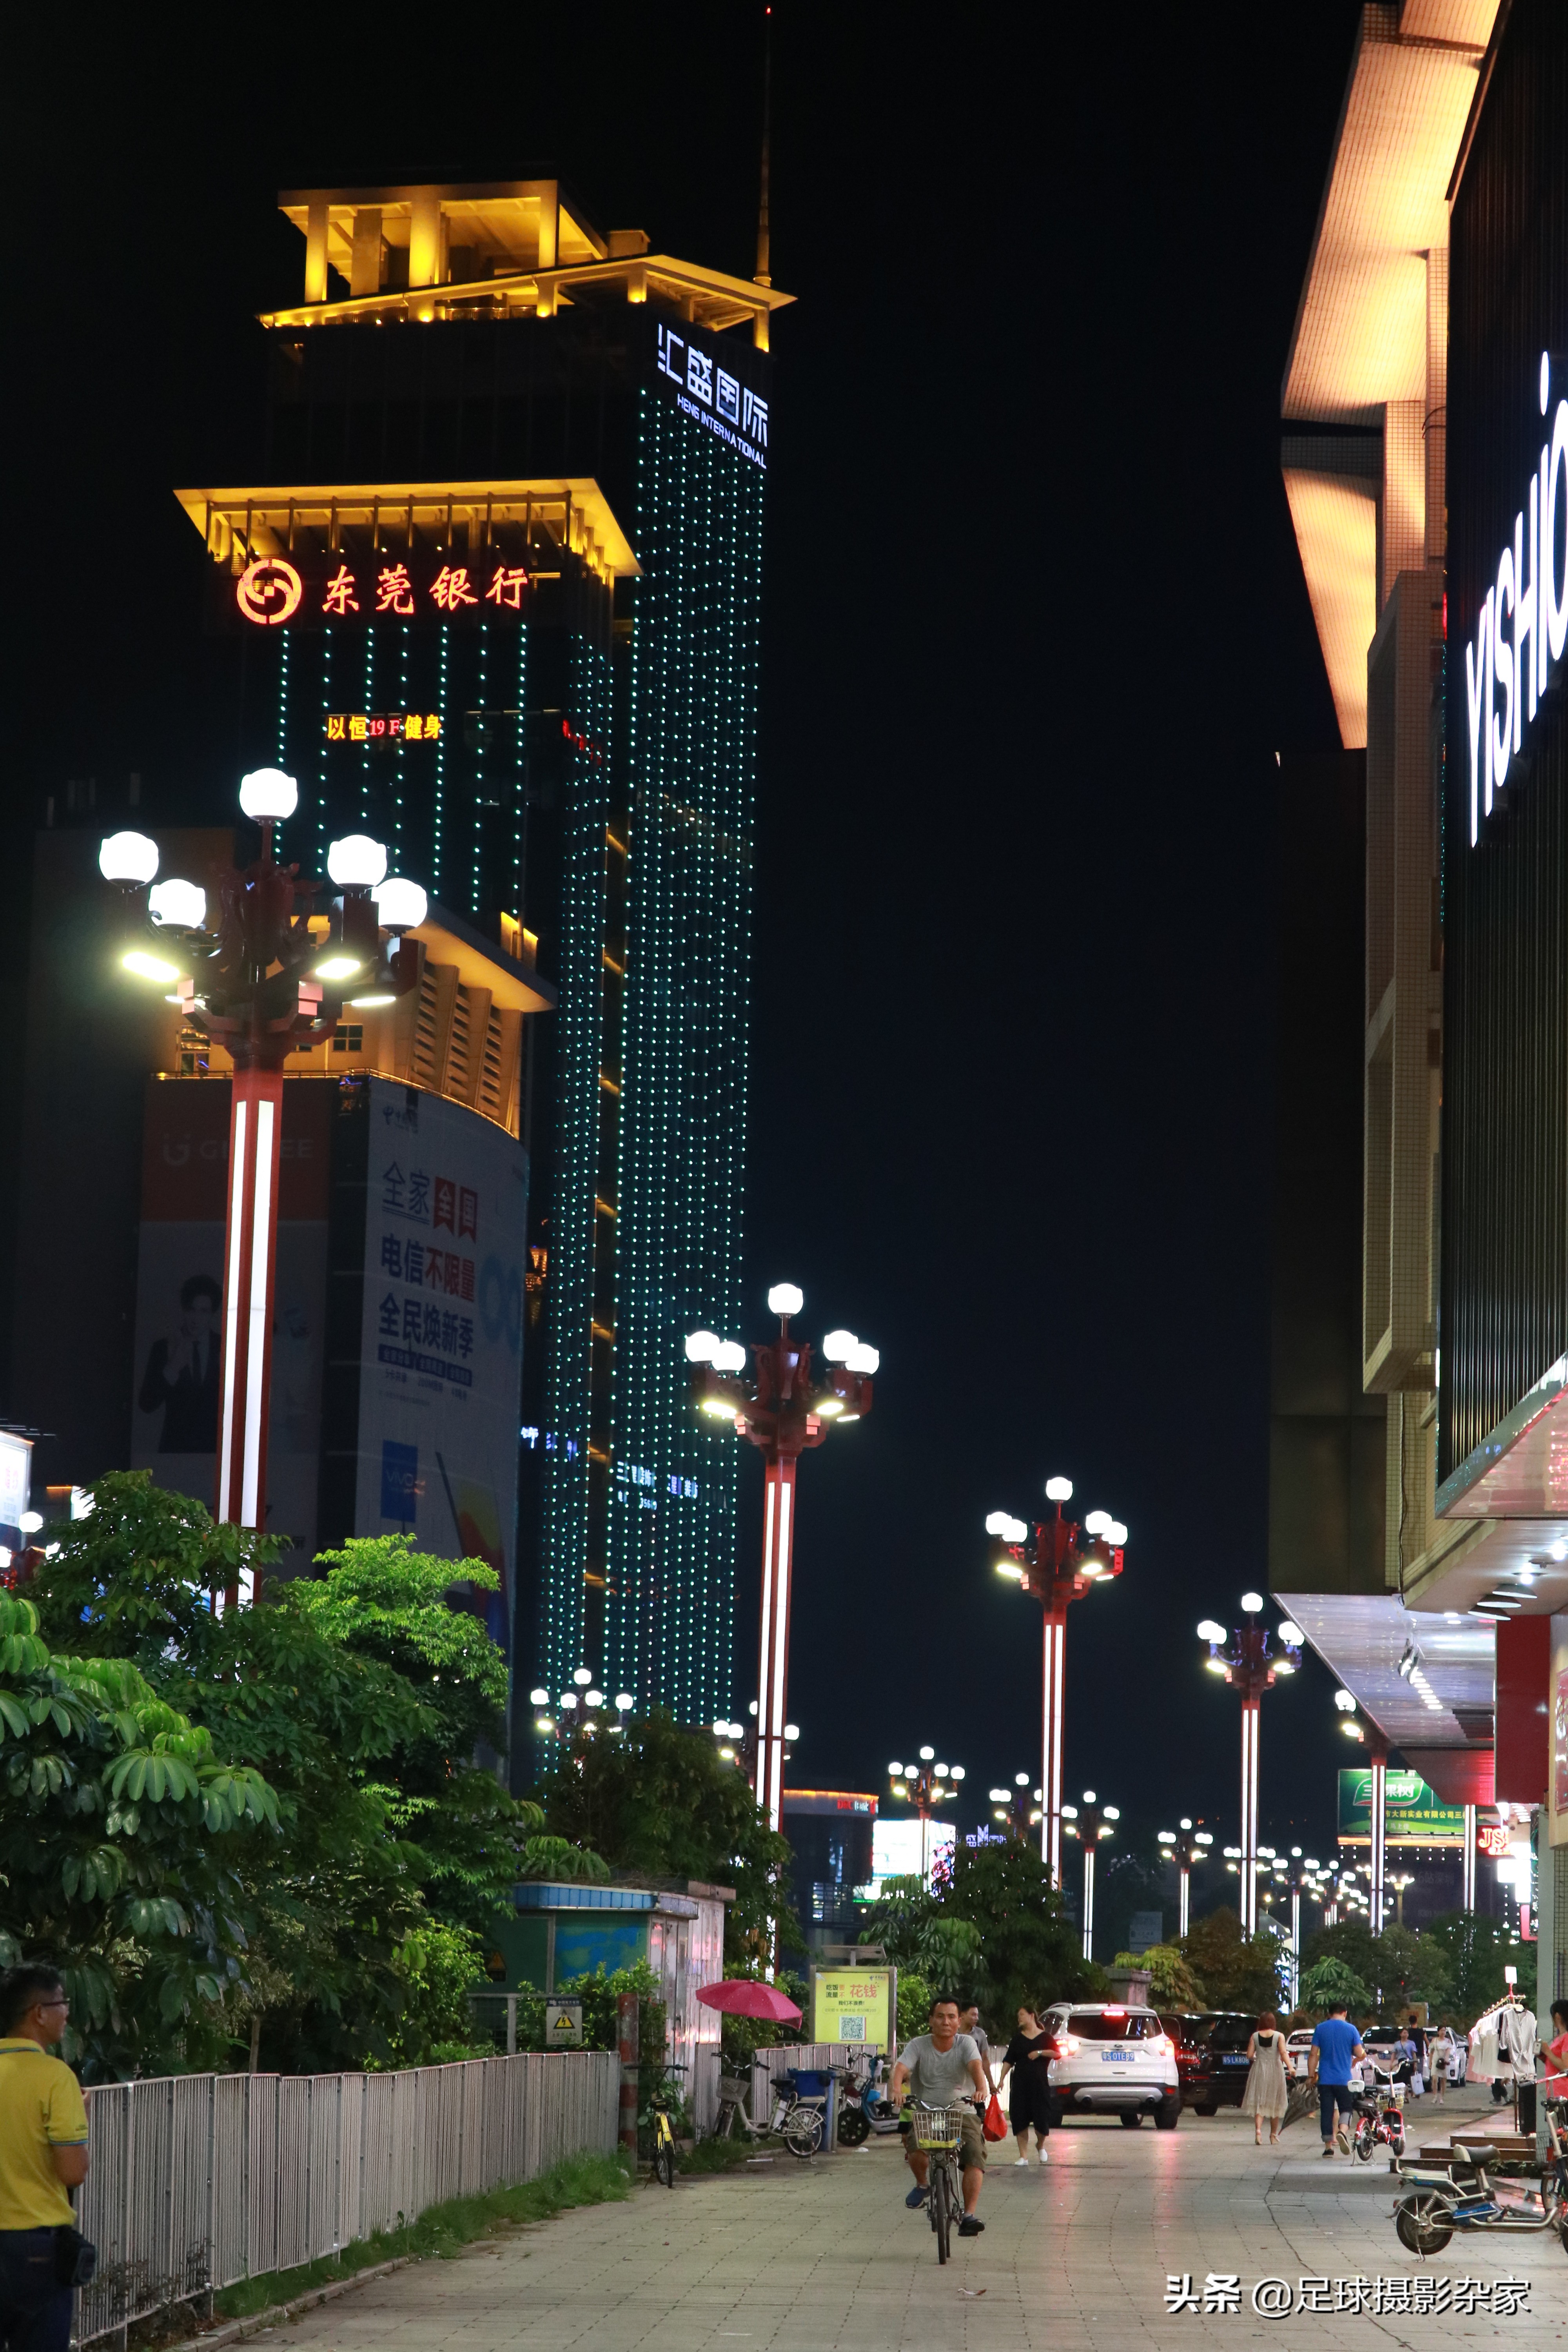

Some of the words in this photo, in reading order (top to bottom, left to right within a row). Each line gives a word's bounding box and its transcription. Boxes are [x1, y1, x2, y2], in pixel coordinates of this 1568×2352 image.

[657, 324, 768, 447] 汇盛国际
[701, 410, 767, 469] INTERNATIONAL
[322, 564, 528, 615] 东莞银行
[200, 1138, 314, 1160] GIEE
[381, 1233, 475, 1303] 电信不限量
[850, 1984, 877, 1998] 花钱
